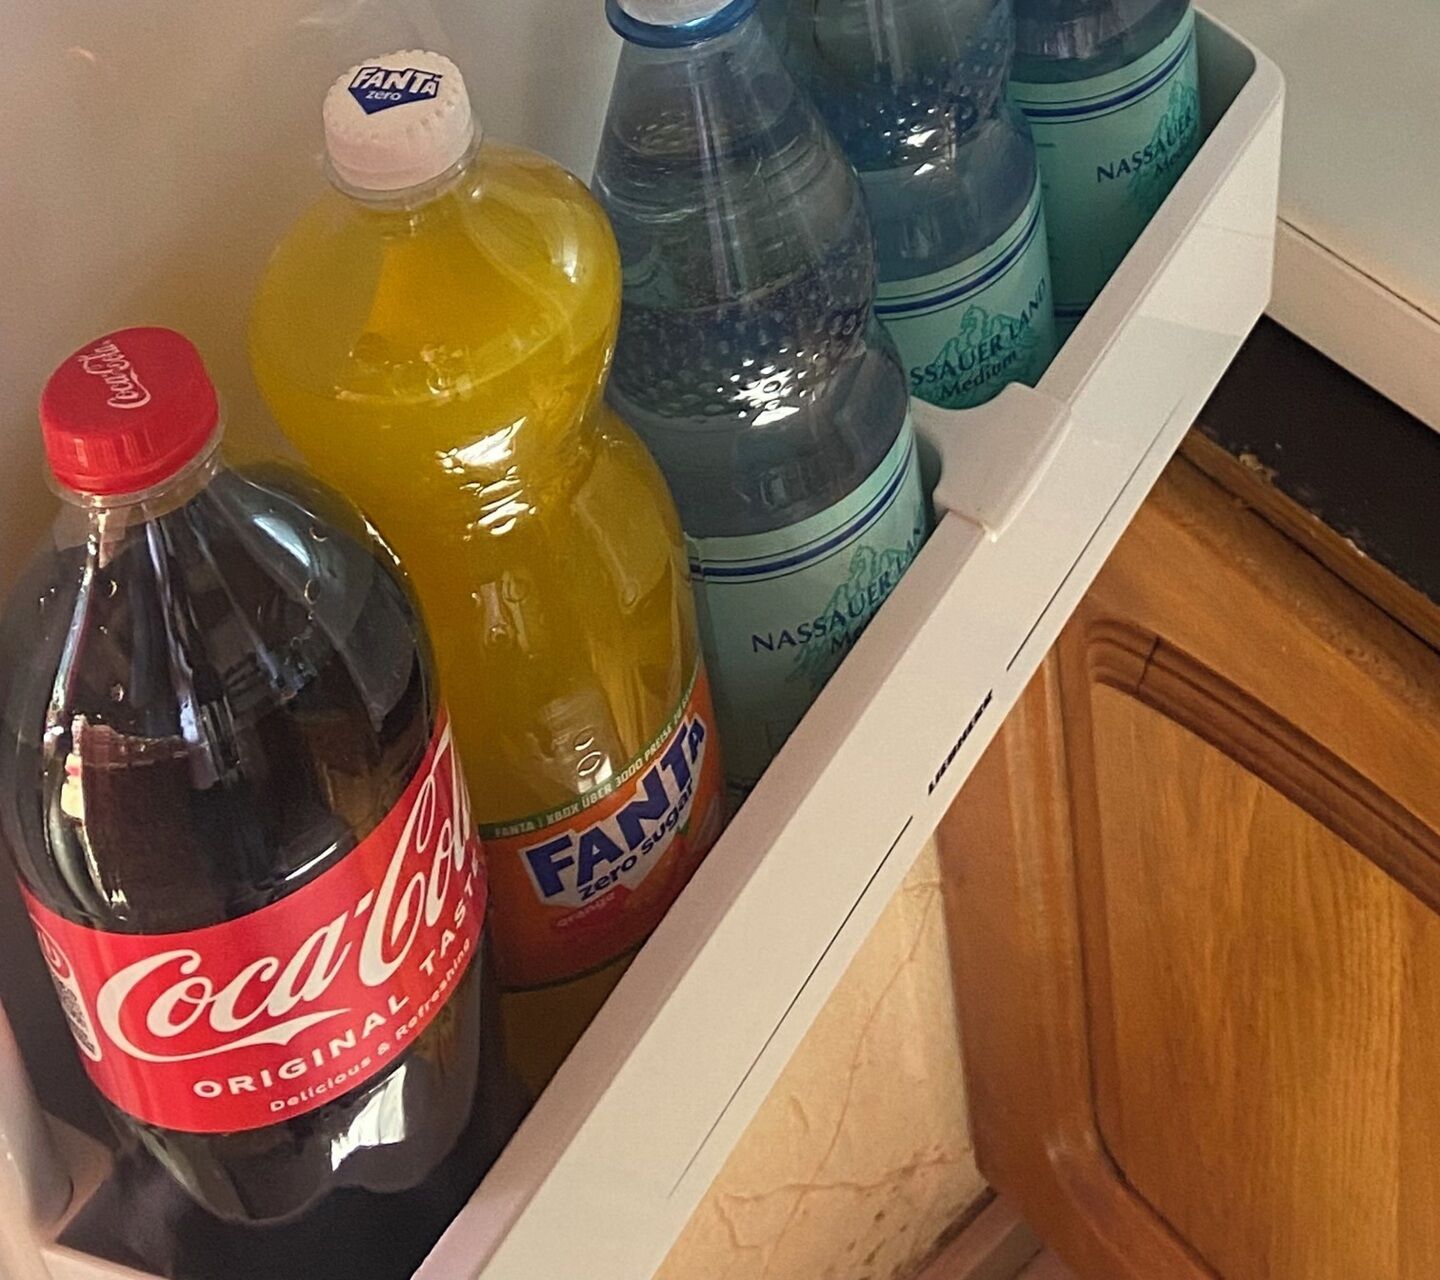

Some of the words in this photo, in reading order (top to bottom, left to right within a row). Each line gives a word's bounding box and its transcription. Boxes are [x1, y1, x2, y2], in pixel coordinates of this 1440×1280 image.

[351, 68, 443, 96] FANTA
[365, 90, 402, 101] zero
[751, 570, 892, 653] NASSAUER
[524, 717, 706, 899] FANTA
[581, 783, 613, 809] ÜBER
[579, 855, 638, 902] zero
[640, 778, 693, 856] sugar
[193, 993, 410, 1099] ORIGINAL
[269, 1055, 372, 1113] Delicious
[376, 1042, 391, 1056] &
